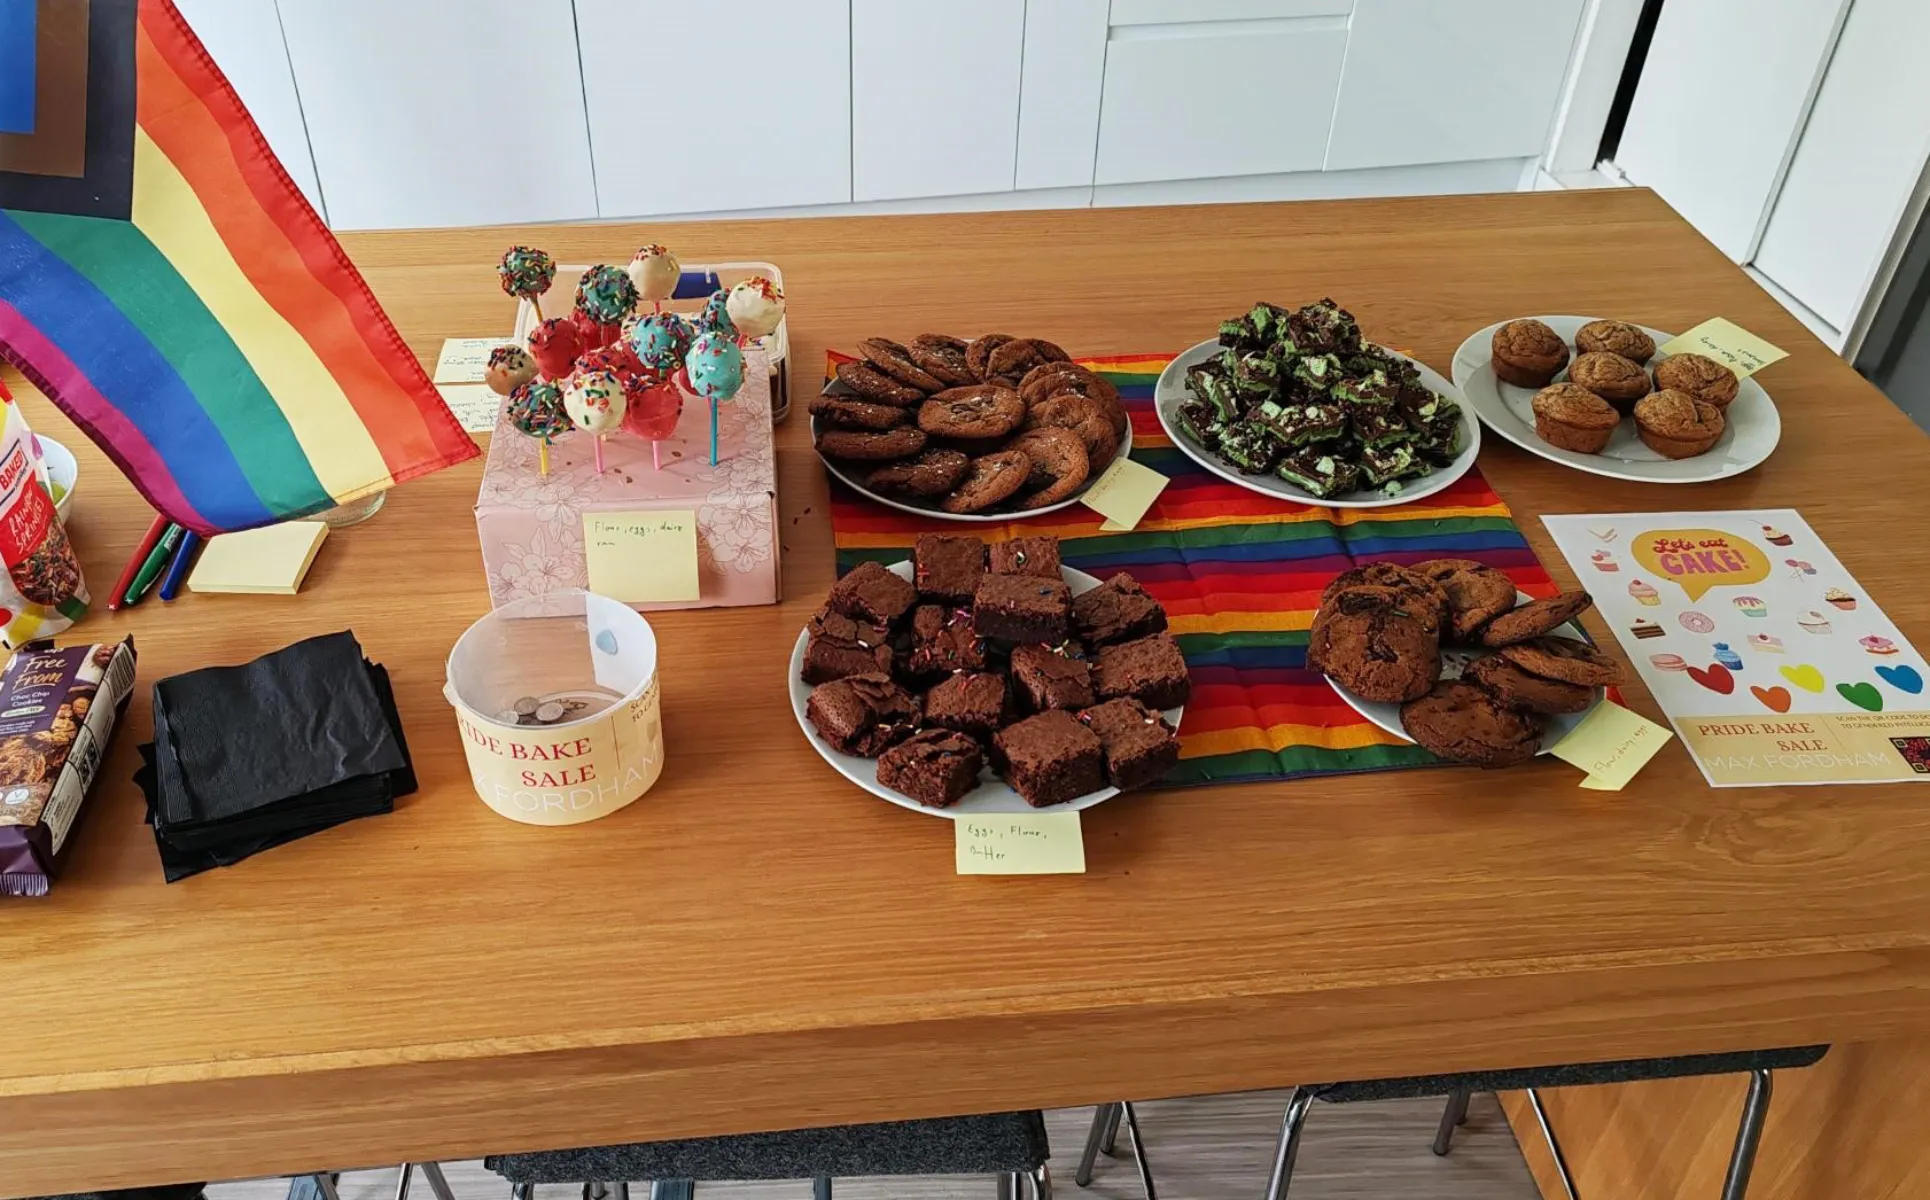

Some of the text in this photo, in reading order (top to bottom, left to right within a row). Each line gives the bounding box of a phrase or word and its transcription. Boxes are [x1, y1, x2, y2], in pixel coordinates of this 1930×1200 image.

[1653, 538, 1729, 553] Let's eat
[1661, 549, 1750, 575] CAKE!
[23, 655, 69, 673] Free
[12, 670, 64, 691] From
[458, 711, 593, 761] RIDE BAKE
[1698, 722, 1815, 737] PRIDE BAKE
[1776, 739, 1828, 752] SALE
[1704, 751, 1892, 772] MAX FORDHAM
[493, 739, 658, 813] FORDHAM
[522, 764, 596, 788] SALE
